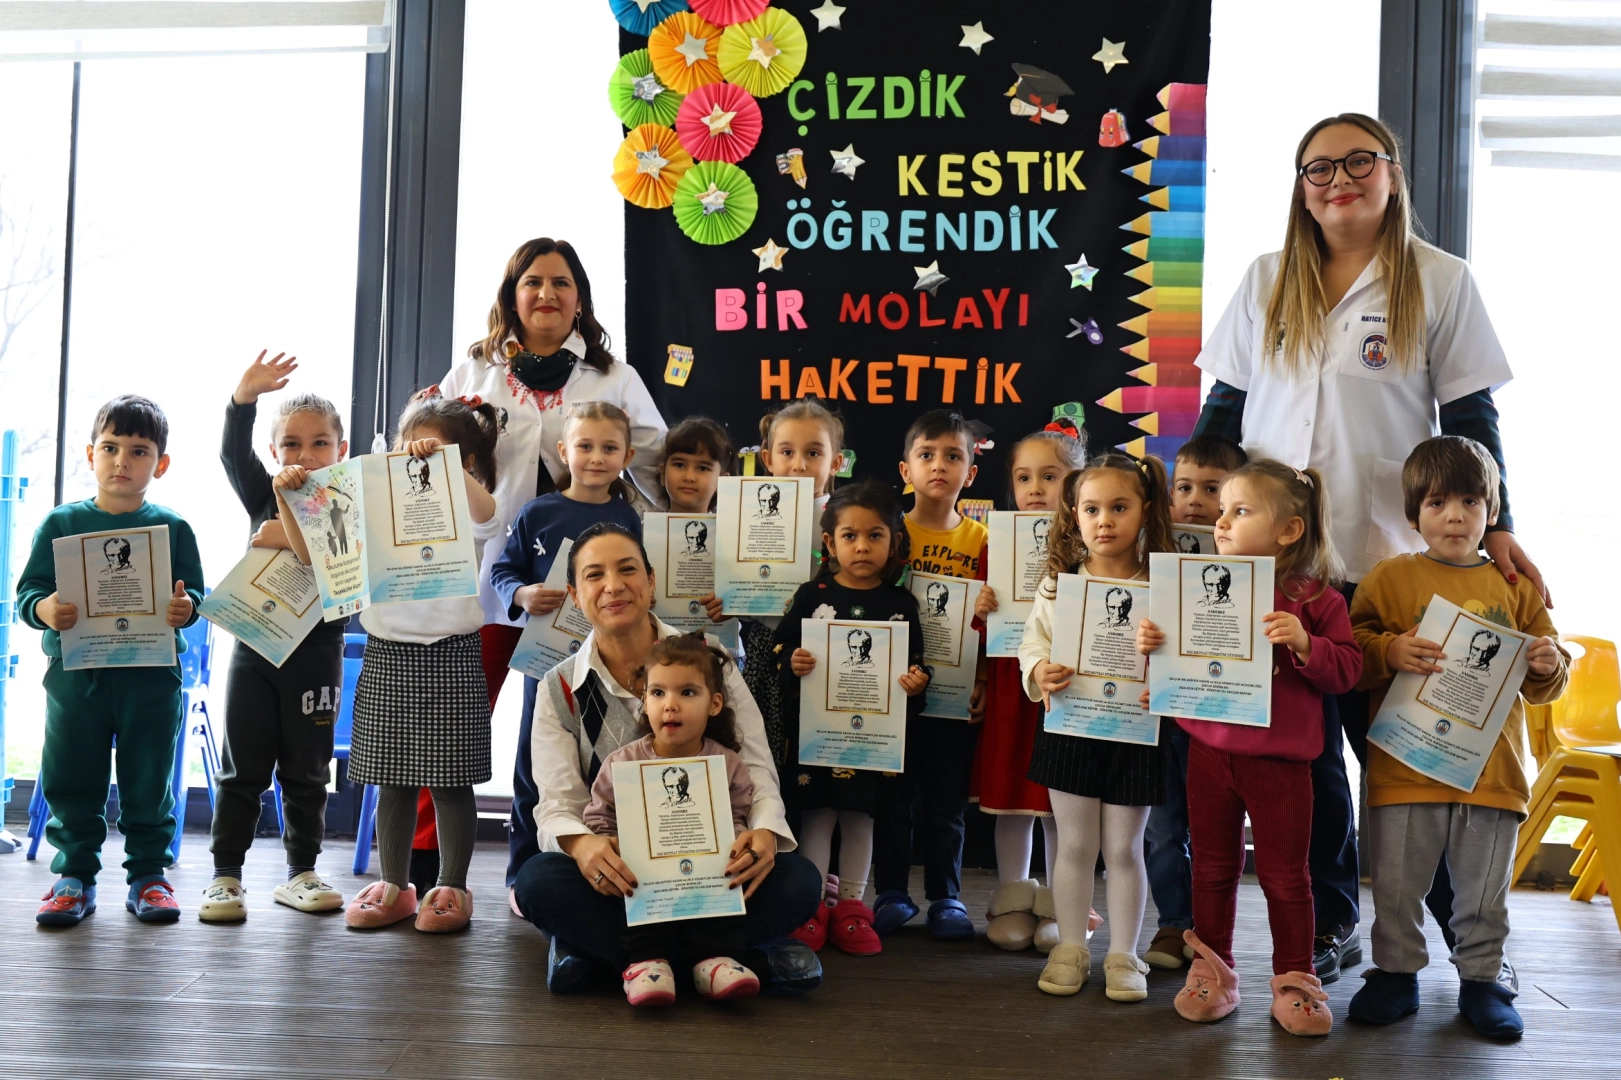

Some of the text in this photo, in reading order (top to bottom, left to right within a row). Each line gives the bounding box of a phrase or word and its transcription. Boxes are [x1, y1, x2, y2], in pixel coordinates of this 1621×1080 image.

[787, 69, 967, 136] ÇİZDİK
[898, 149, 1087, 197] KESTİK
[786, 198, 1059, 252] ÖĞRENDİK
[714, 281, 1031, 332] BİR MOLAYI
[760, 353, 1022, 404] HAKETTİK
